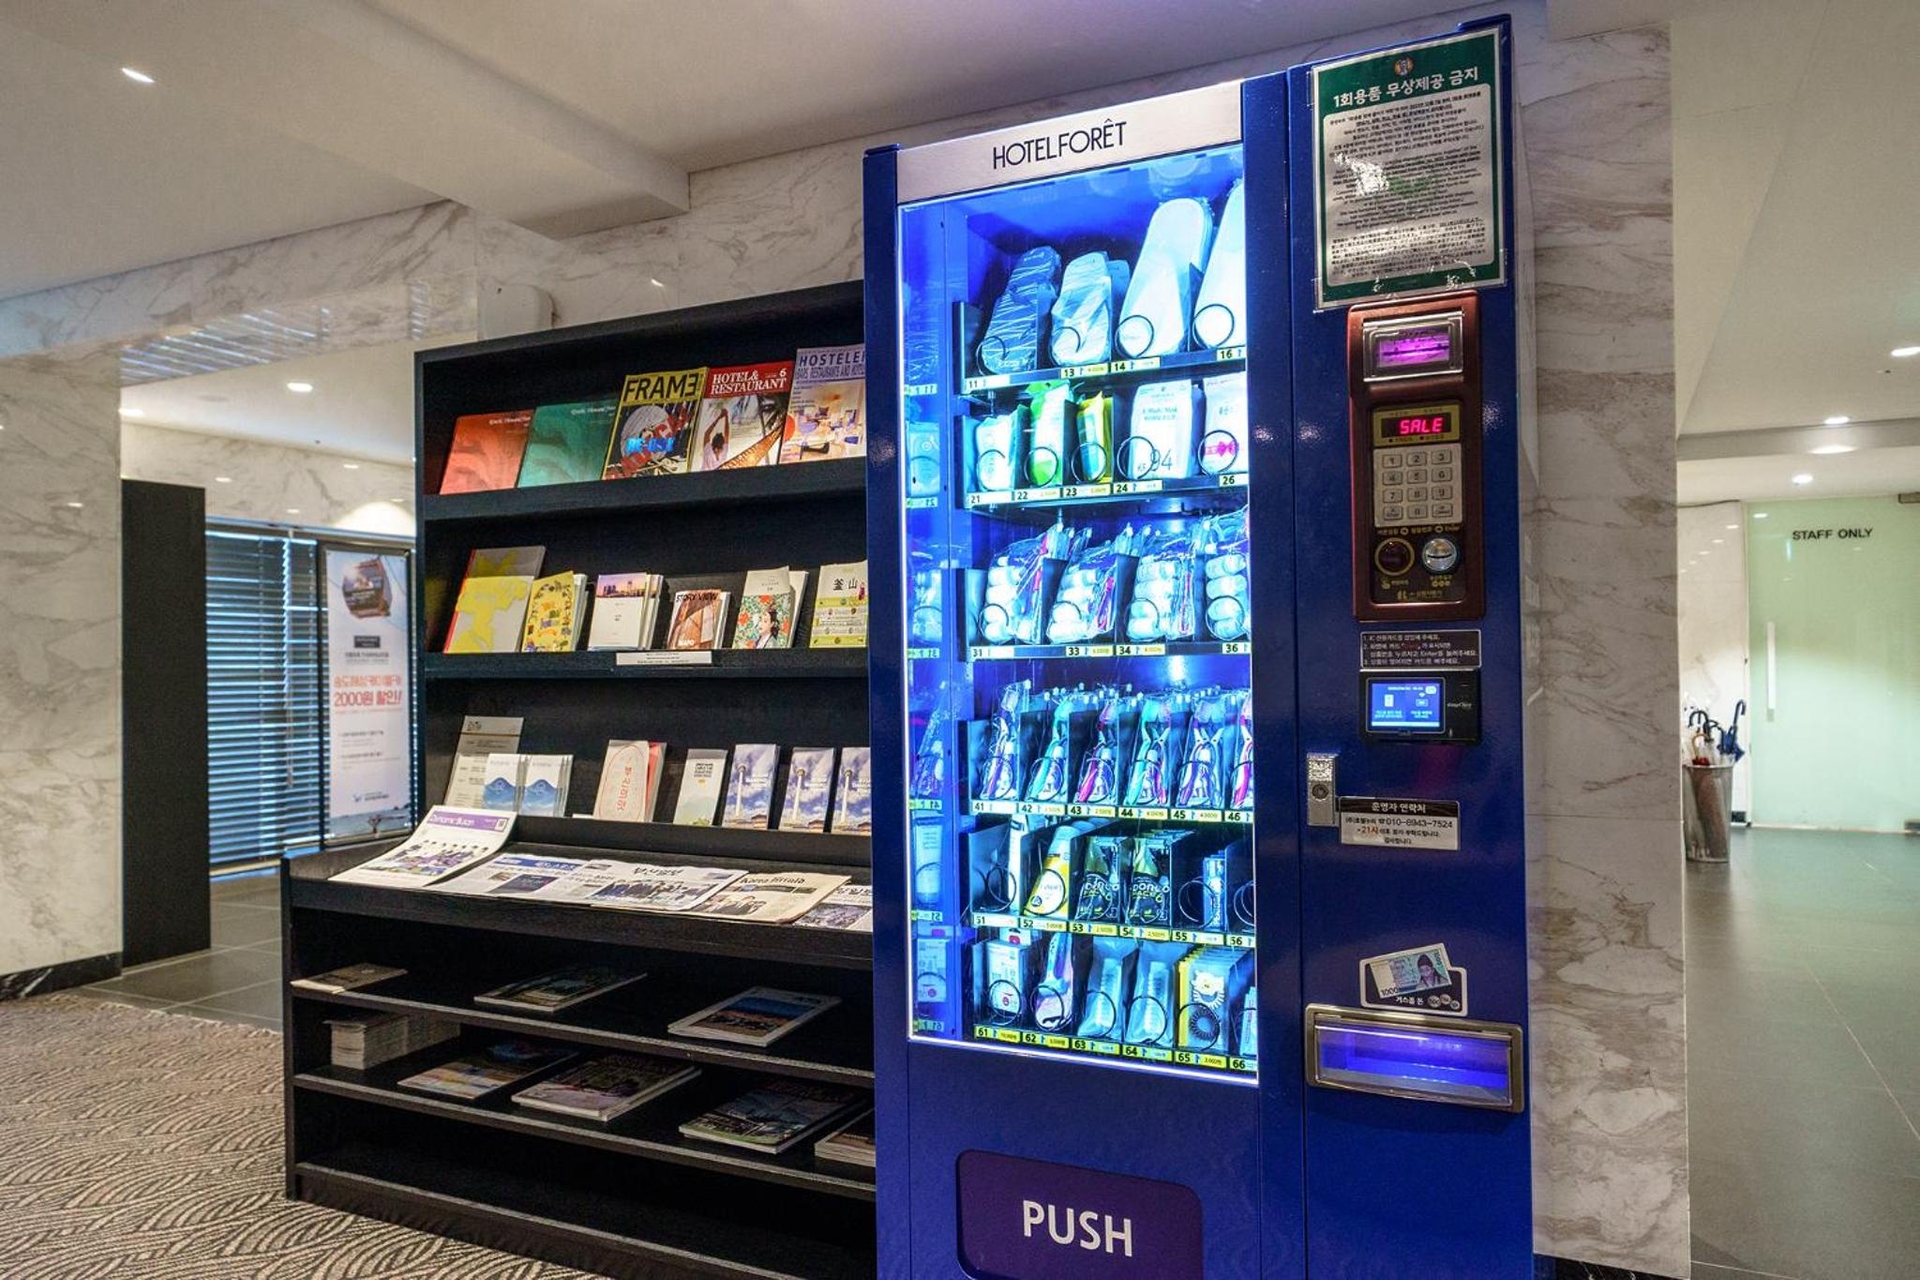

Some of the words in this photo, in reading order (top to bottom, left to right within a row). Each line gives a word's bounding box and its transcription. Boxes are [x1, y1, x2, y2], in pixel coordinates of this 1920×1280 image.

[1333, 85, 1382, 108] 1회용품
[1386, 74, 1444, 97] 무상제공
[1448, 66, 1478, 86] 금지
[1220, 350, 1232, 359] 16
[1114, 362, 1126, 371] 14
[779, 368, 788, 378] 6
[1064, 368, 1075, 376] 13
[712, 370, 759, 385] HOTEL&
[710, 377, 787, 395] RESTAURANT
[969, 380, 978, 388] 11
[1399, 416, 1444, 435] SALE
[1222, 476, 1235, 485] 26
[1066, 488, 1078, 496] 23
[1116, 484, 1128, 493] 24
[970, 495, 980, 504] 21
[1017, 492, 1028, 500] 22
[1792, 530, 1833, 540] STAFF
[1838, 528, 1874, 539] ONLY
[972, 648, 983, 658] 31
[1068, 646, 1080, 656] 33
[1119, 646, 1132, 655] 34
[1226, 644, 1238, 653] 36
[974, 803, 984, 811] 41
[1021, 804, 1032, 813] 42
[1070, 806, 1082, 815] 43
[1120, 808, 1133, 818] 44
[1174, 810, 1186, 819] 45
[1228, 812, 1240, 821] 46
[976, 916, 985, 924] 51
[1023, 920, 1034, 928] 52
[1072, 923, 1084, 932] 53
[1175, 932, 1188, 940] 55
[1230, 936, 1242, 946] 56
[978, 1028, 988, 1036] 61
[1025, 1034, 1036, 1042] 62
[1074, 1040, 1086, 1050] 63
[1126, 1046, 1138, 1056] 64
[1178, 1053, 1190, 1062] 65
[1232, 1060, 1246, 1070] 66
[1022, 1200, 1133, 1258] PUSH
